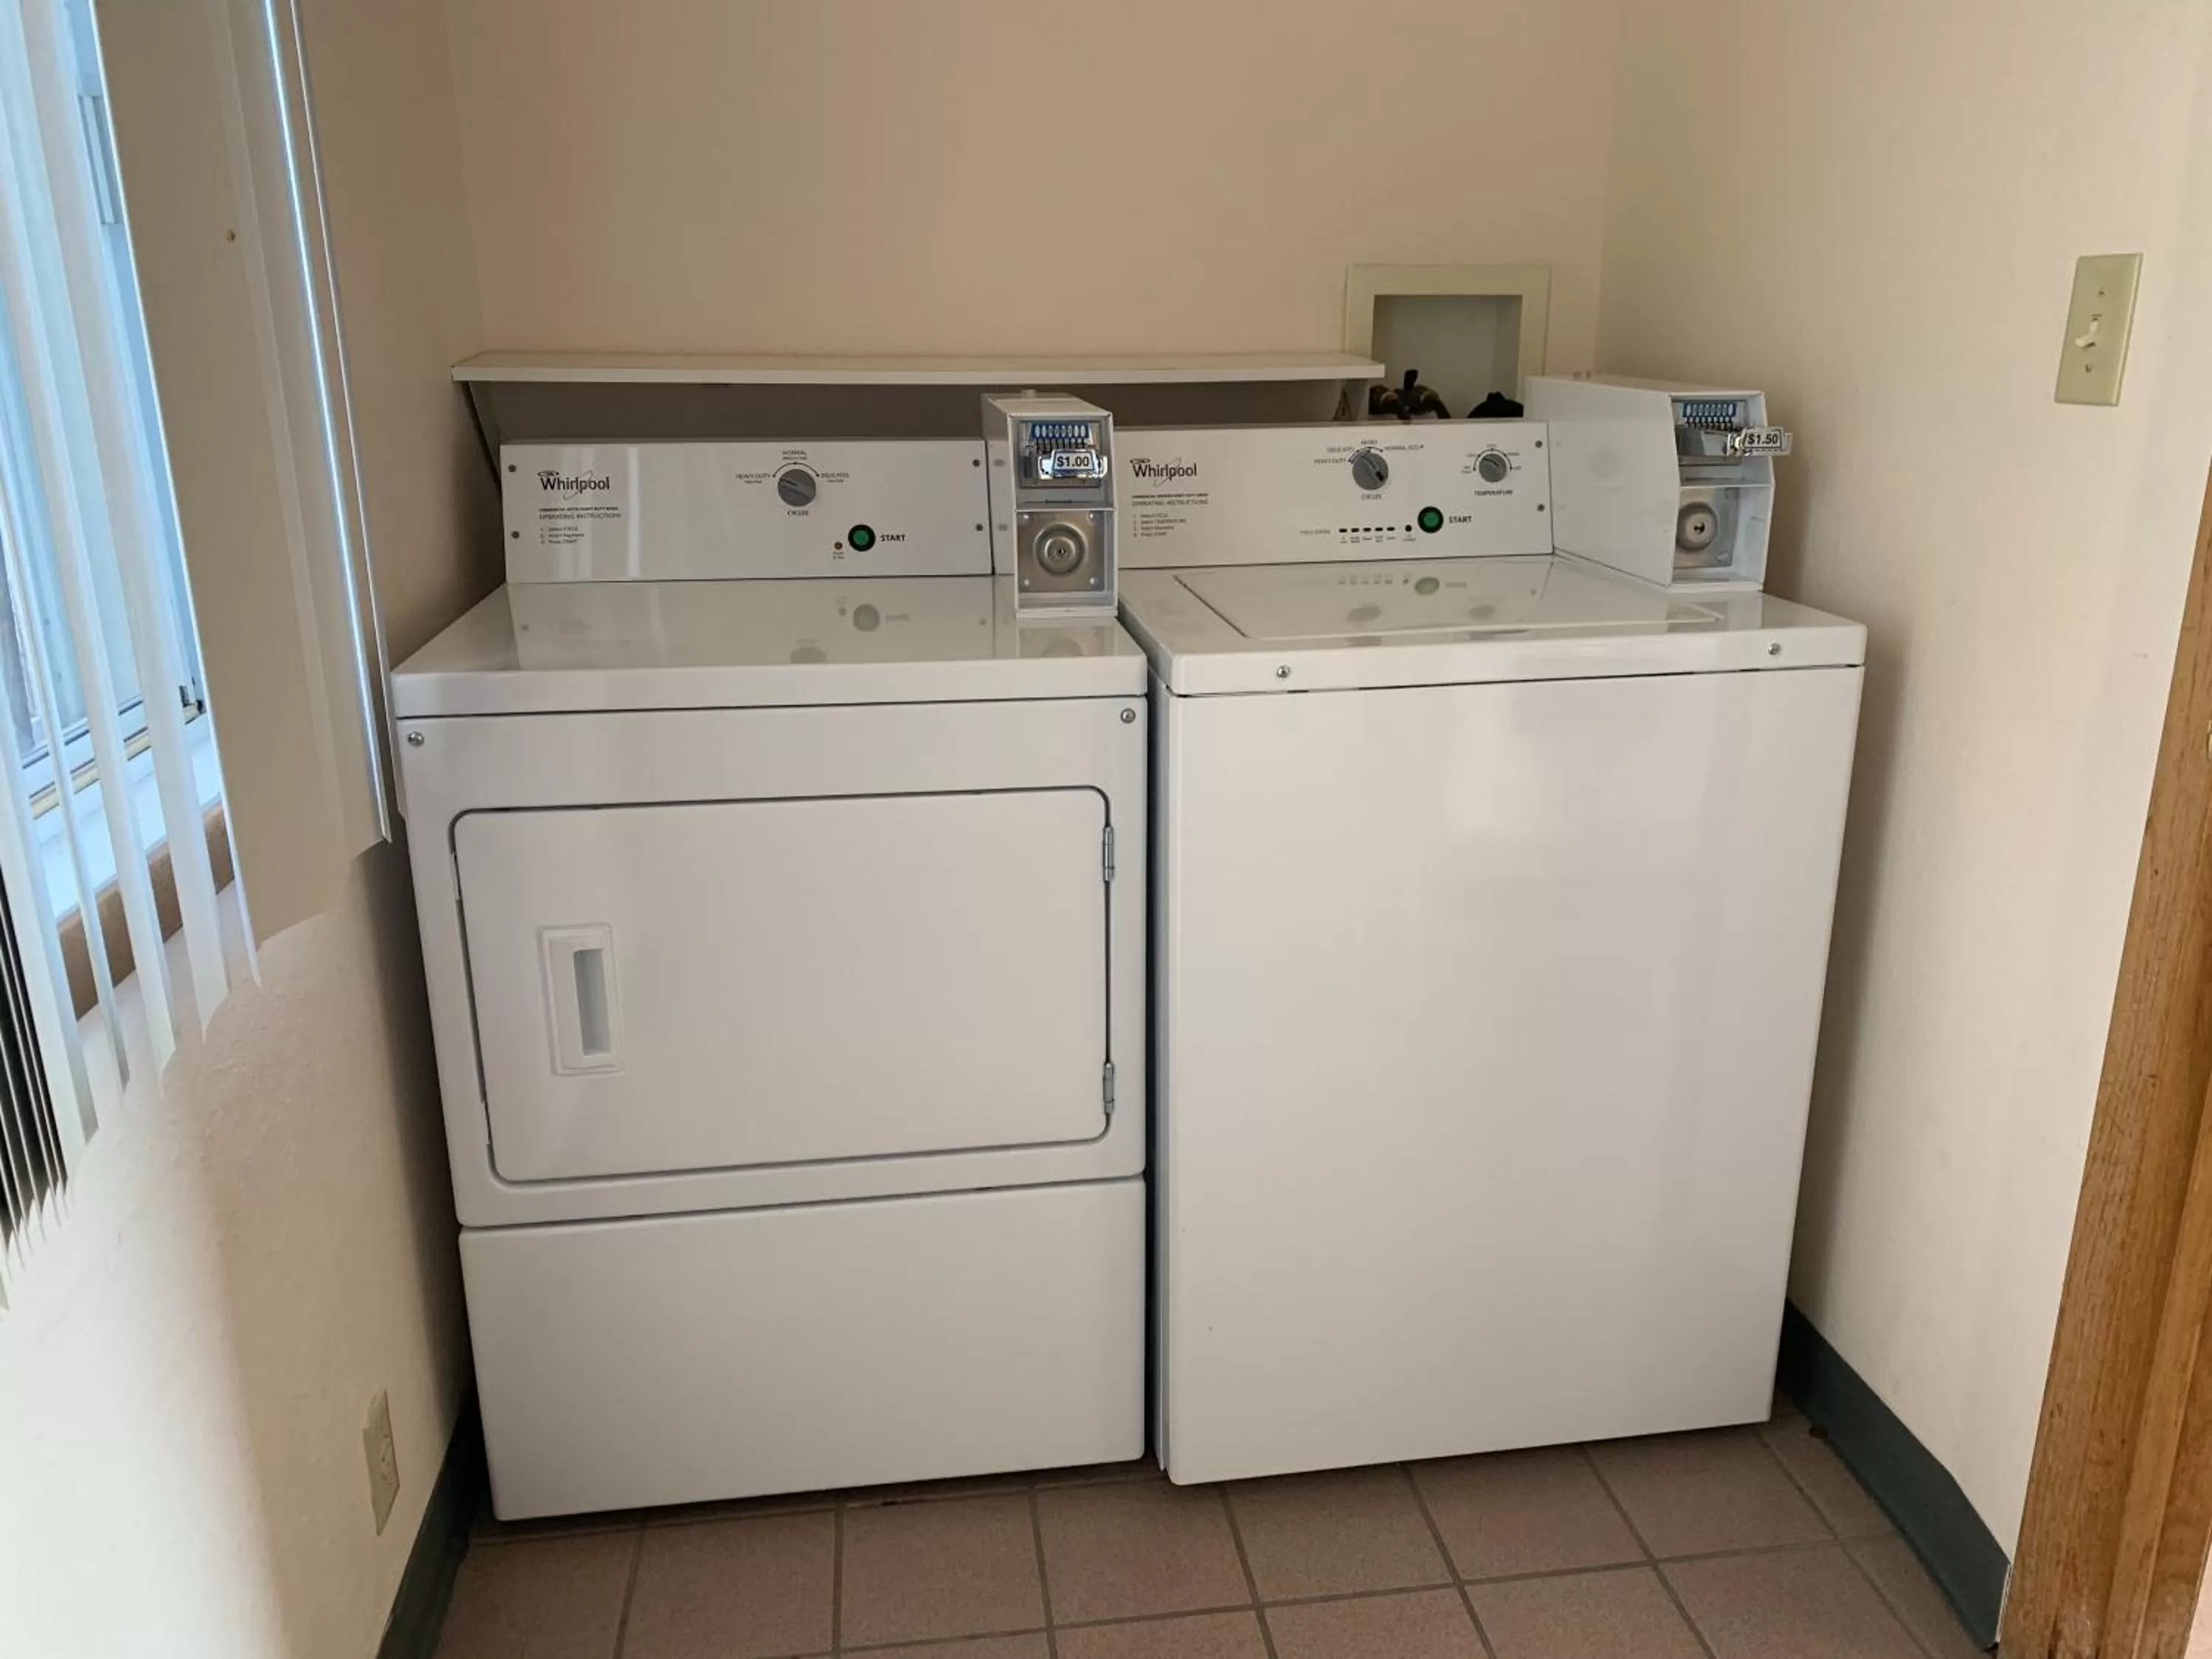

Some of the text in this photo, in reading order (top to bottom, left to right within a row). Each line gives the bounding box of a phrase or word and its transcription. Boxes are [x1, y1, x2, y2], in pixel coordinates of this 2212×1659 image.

[1747, 434, 1778, 445] $1.50
[1057, 456, 1089, 467] $1.00
[1132, 462, 1197, 481] Whirlpool
[540, 476, 610, 494] Whirlpool
